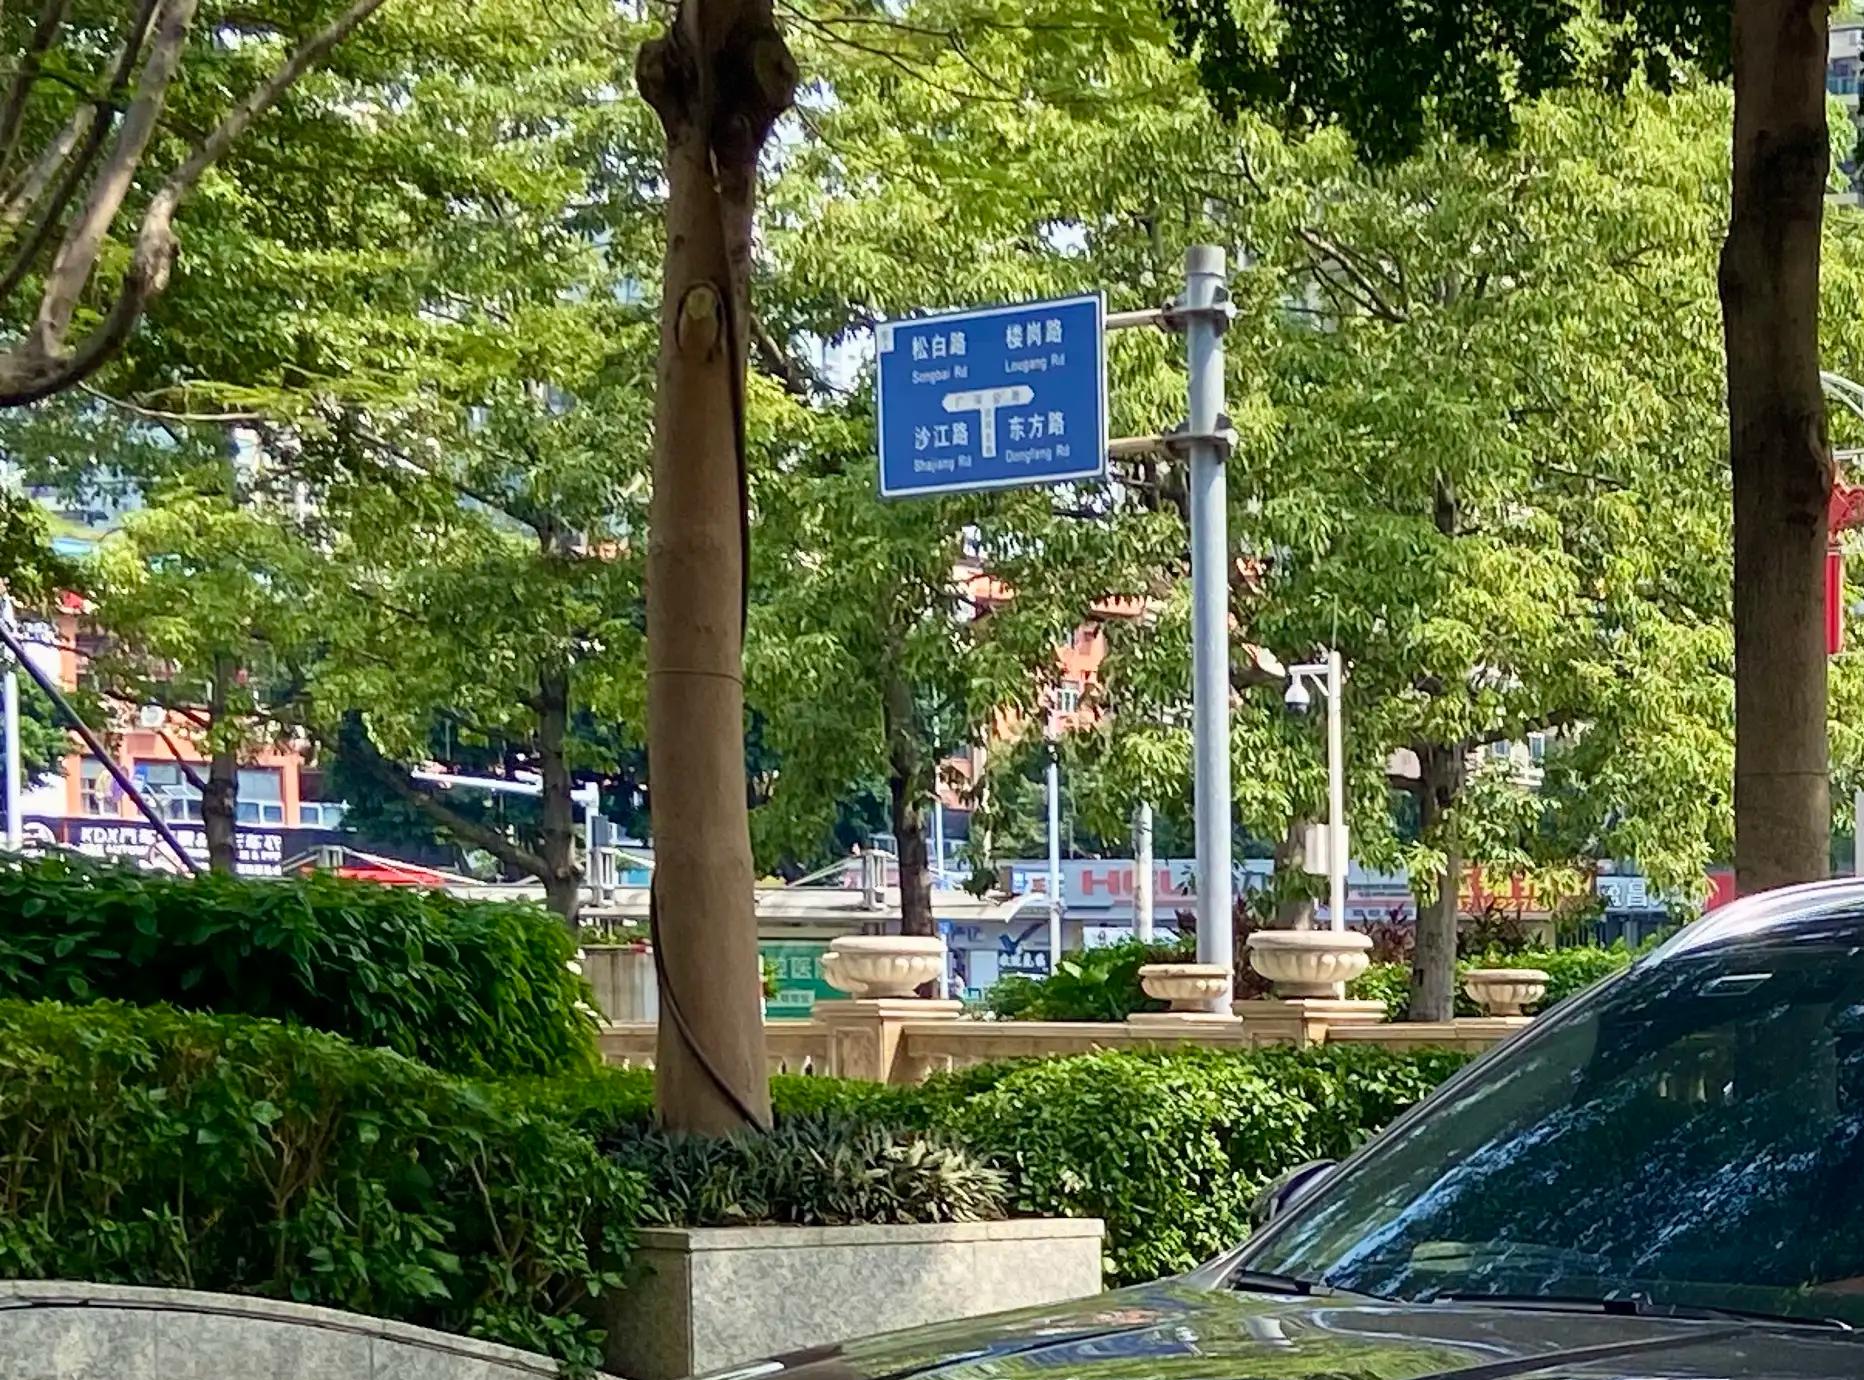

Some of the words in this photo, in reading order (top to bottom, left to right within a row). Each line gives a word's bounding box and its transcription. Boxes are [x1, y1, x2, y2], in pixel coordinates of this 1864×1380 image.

[1006, 319, 1062, 349] 楼岗路
[912, 331, 966, 361] 松白路
[1051, 353, 1065, 367] Rd
[954, 364, 968, 378] Rd
[914, 422, 968, 450] 沙江路
[1008, 412, 1065, 441] 东方路
[958, 453, 971, 468] Rd
[1056, 443, 1070, 458] Rd
